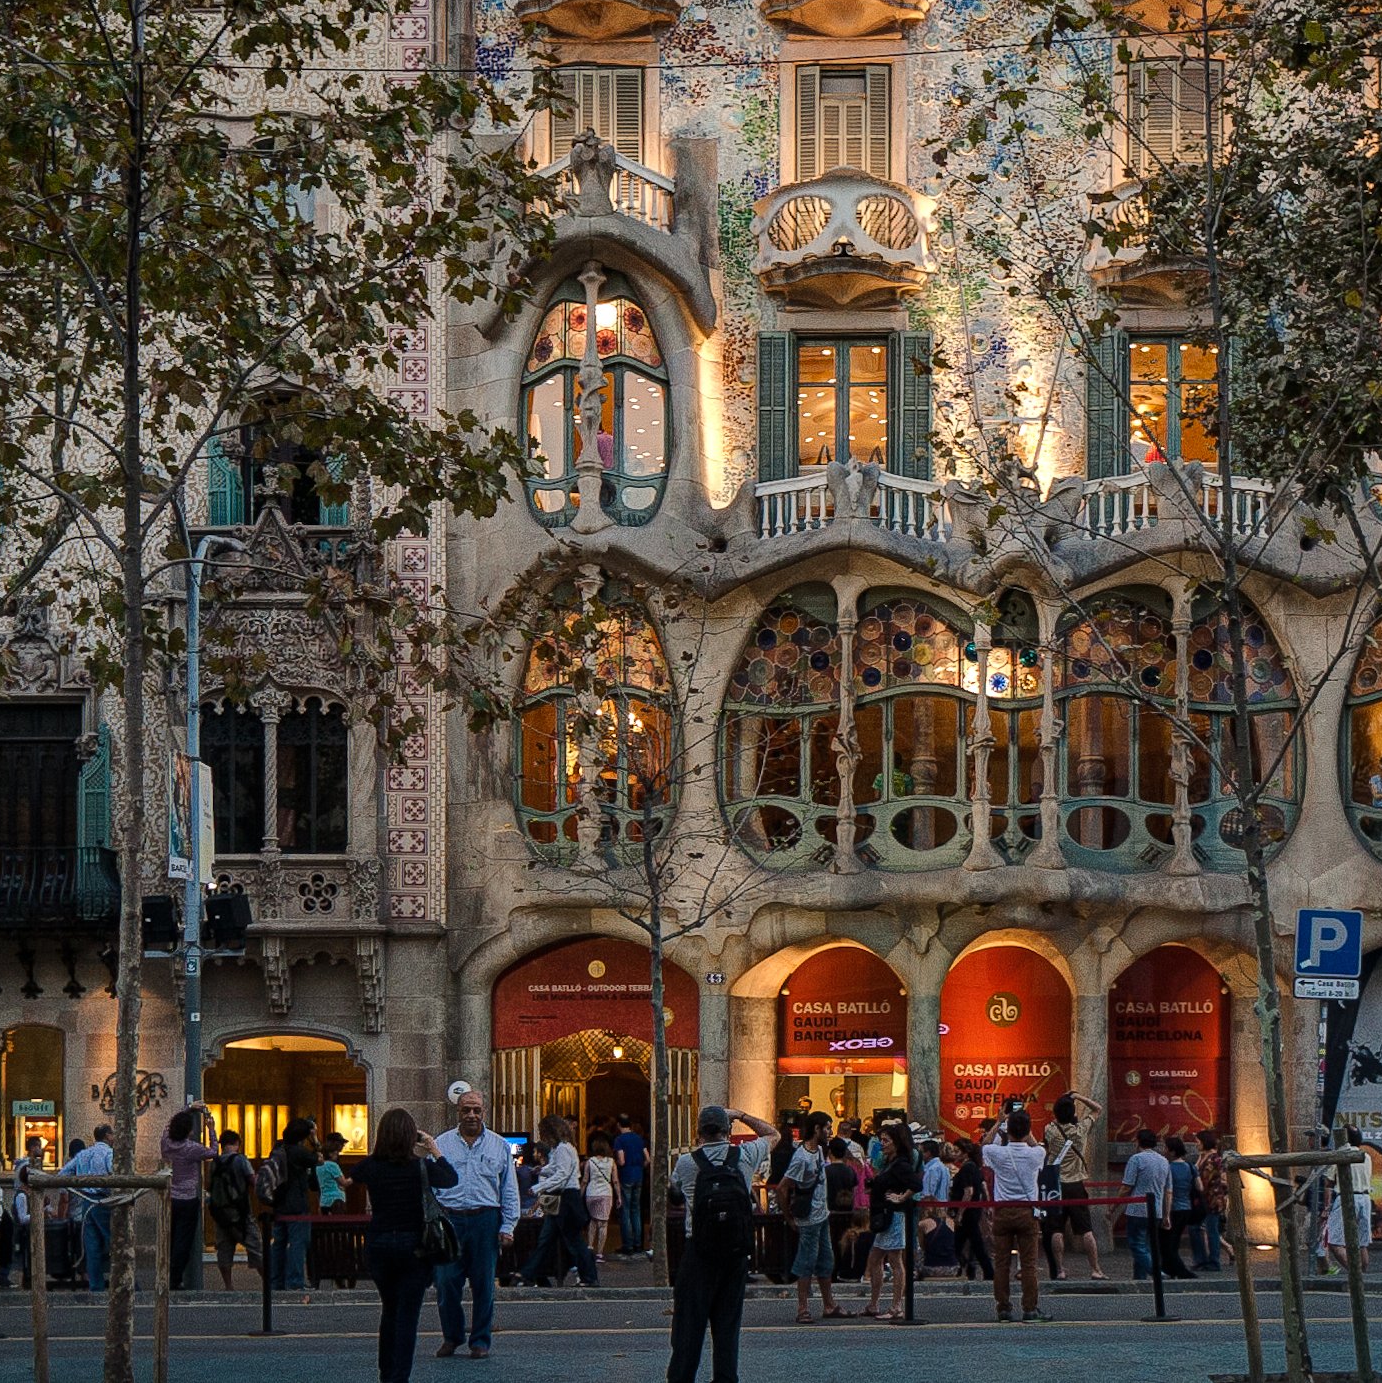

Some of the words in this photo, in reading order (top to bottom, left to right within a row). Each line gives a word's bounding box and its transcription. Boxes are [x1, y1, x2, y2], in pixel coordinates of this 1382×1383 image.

[1310, 917, 1348, 967] P
[706, 973, 723, 984] 43
[1318, 979, 1333, 987] Casa
[528, 984, 550, 992] CASA
[588, 984, 627, 992] OUTDOOR
[792, 1002, 833, 1014] CASA
[837, 999, 891, 1014] BATLLÓ
[1115, 1001, 1155, 1014] CASA
[1159, 999, 1214, 1014] BATLLÓ
[1116, 1030, 1203, 1041] BARCELONA
[953, 1063, 994, 1077] CASA
[997, 1061, 1051, 1077] BATLLÓ
[1171, 1068, 1198, 1077] BATLLÓ
